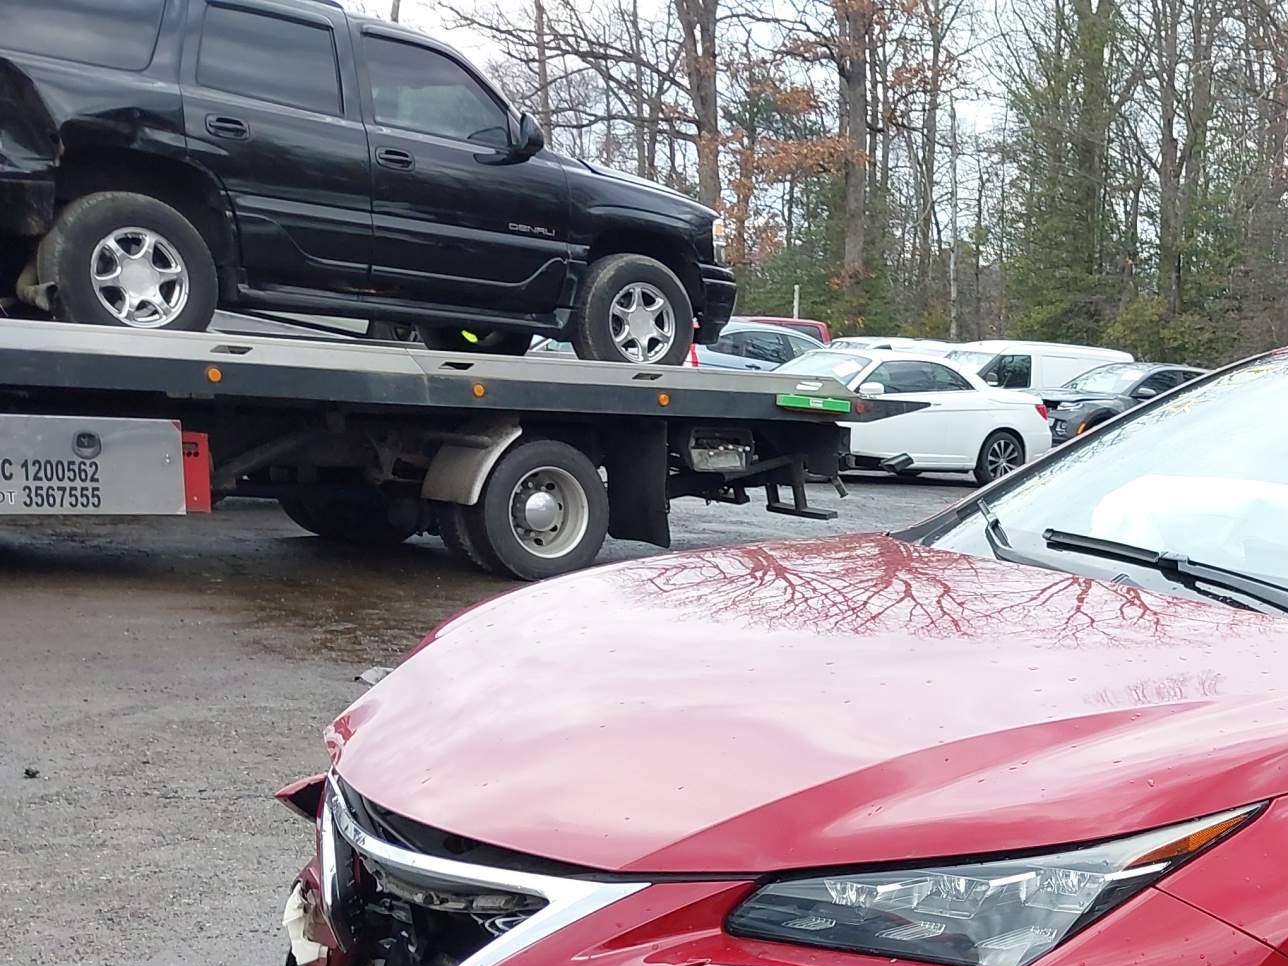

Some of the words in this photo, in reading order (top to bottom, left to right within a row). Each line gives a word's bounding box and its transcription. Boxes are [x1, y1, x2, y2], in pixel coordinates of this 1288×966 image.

[508, 223, 556, 237] DENALI
[20, 458, 100, 483] 1200562
[22, 485, 102, 508] 3567555
